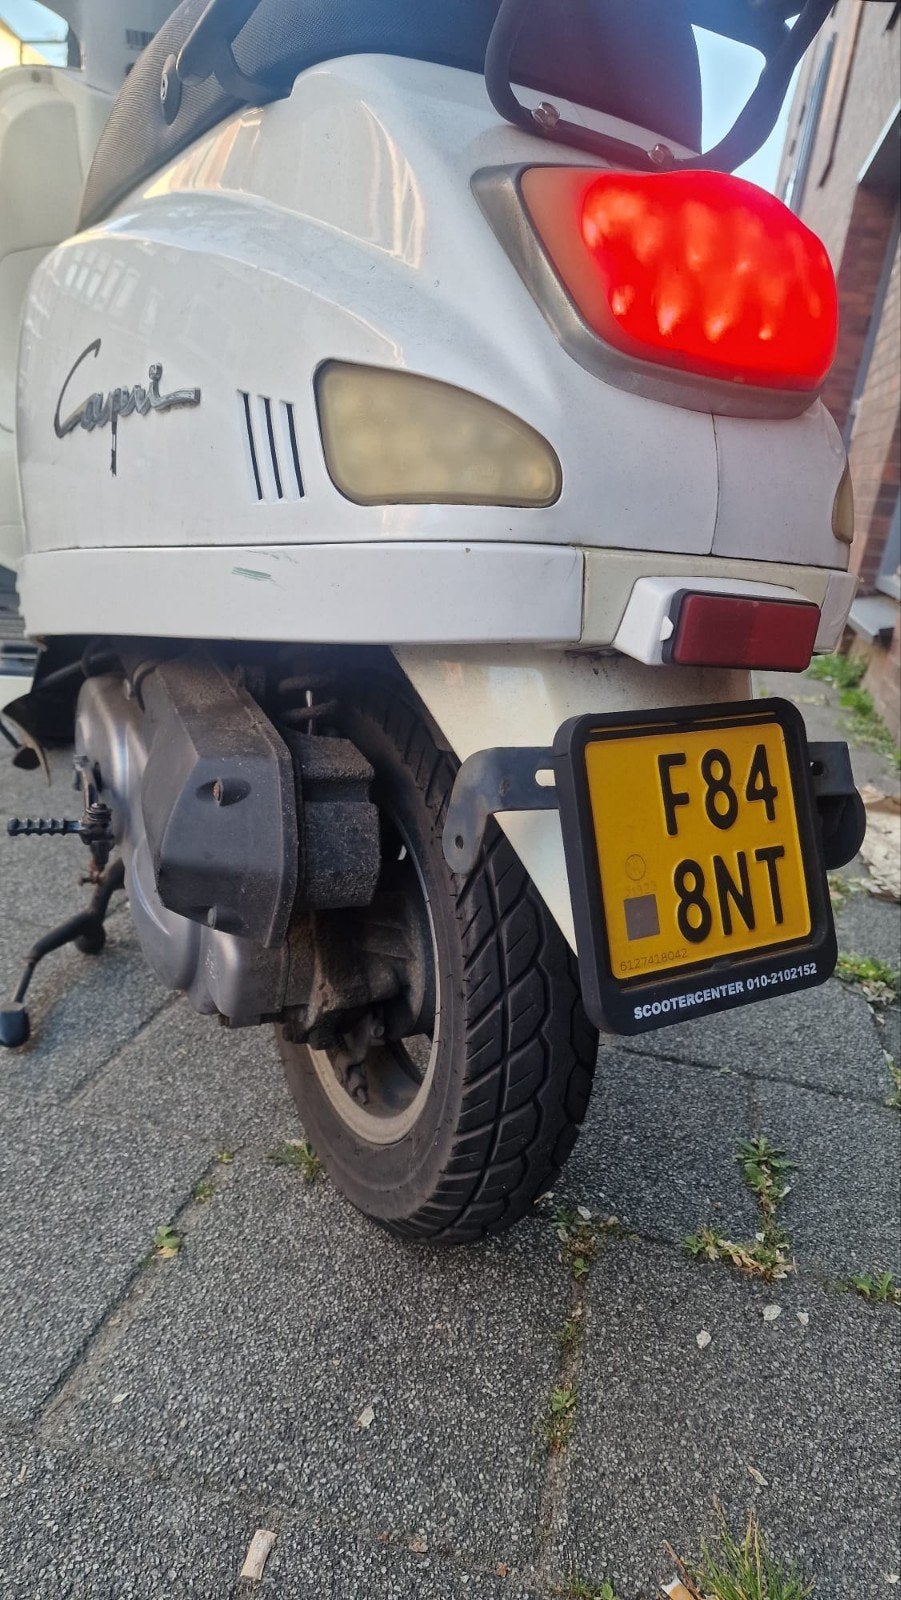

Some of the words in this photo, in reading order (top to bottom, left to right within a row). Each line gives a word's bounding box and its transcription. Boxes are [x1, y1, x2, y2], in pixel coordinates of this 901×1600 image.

[54, 338, 201, 476] Capri
[658, 744, 778, 836] F84
[674, 846, 785, 943] 8NT
[634, 981, 744, 1019] SCOOTERCENTER
[746, 963, 817, 990] 010-2102152
